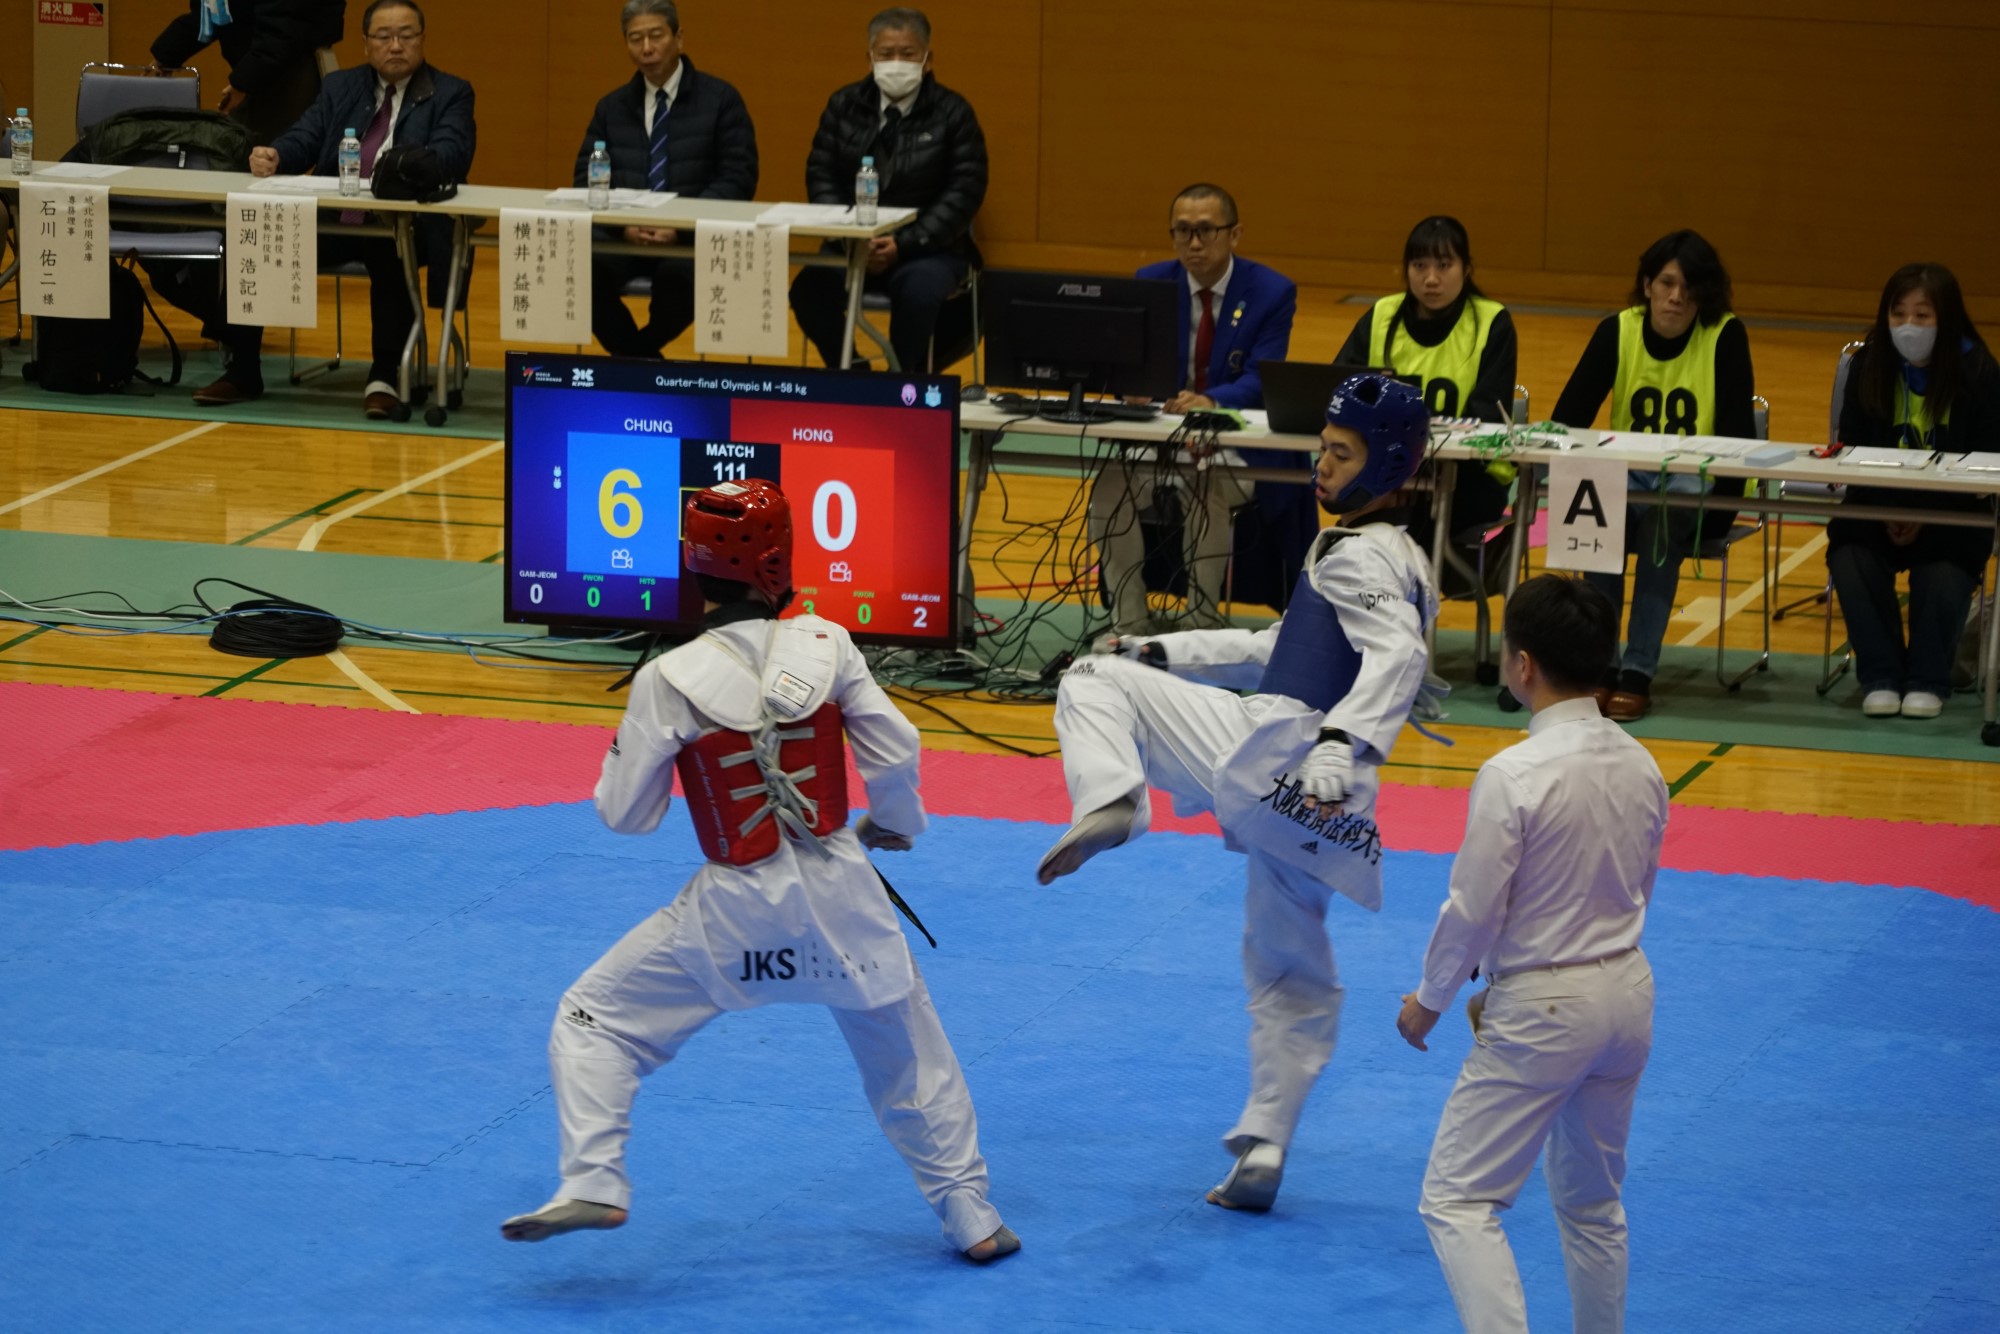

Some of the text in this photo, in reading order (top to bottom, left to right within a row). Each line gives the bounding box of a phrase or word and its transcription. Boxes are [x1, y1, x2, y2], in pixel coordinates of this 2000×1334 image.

[1057, 283, 1102, 297] ASUS
[655, 375, 718, 389] Quarter-final
[721, 378, 761, 392] Olympic
[762, 382, 772, 392] M
[795, 384, 808, 397] kg
[1630, 386, 1698, 436] 88
[623, 418, 673, 433] CHUNG
[792, 428, 834, 443] HONG
[706, 443, 755, 458] MATCH
[713, 462, 746, 481] 111
[598, 468, 643, 539] 6
[1563, 478, 1608, 528] A
[812, 480, 857, 551] 0
[1566, 537, 1603, 553] コート
[519, 570, 558, 580] GAM-JEOM
[639, 577, 656, 586] HITS
[529, 583, 544, 604] 0
[586, 586, 601, 608] 0
[640, 590, 651, 611] 1
[901, 593, 941, 602] GAM-JEOM
[802, 600, 816, 615] 3
[857, 603, 872, 624] 0
[913, 606, 928, 628] 2
[739, 948, 797, 982] JKS
